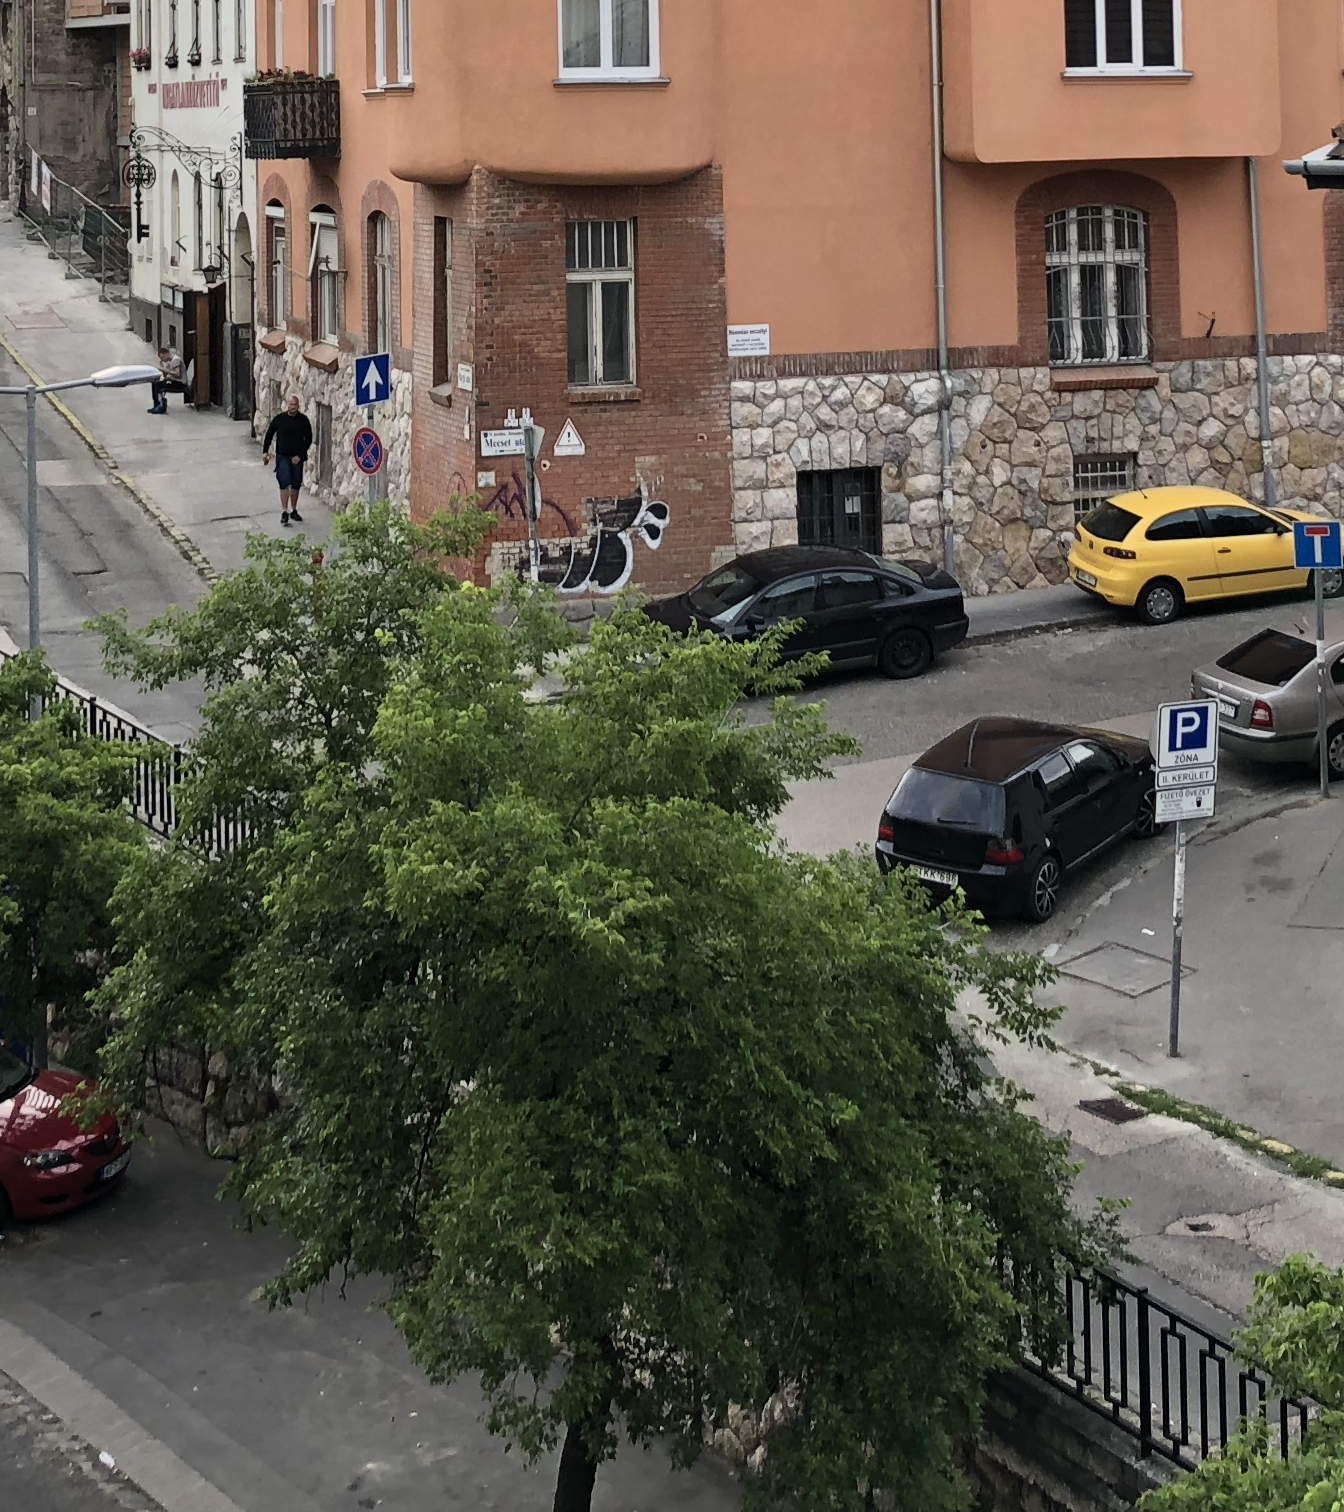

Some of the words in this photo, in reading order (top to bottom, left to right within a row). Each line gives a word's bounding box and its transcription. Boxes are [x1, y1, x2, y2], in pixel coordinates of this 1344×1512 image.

[1176, 711, 1201, 749] P
[1174, 752, 1199, 765] ZÓNA
[1172, 770, 1210, 783] KERÜLET
